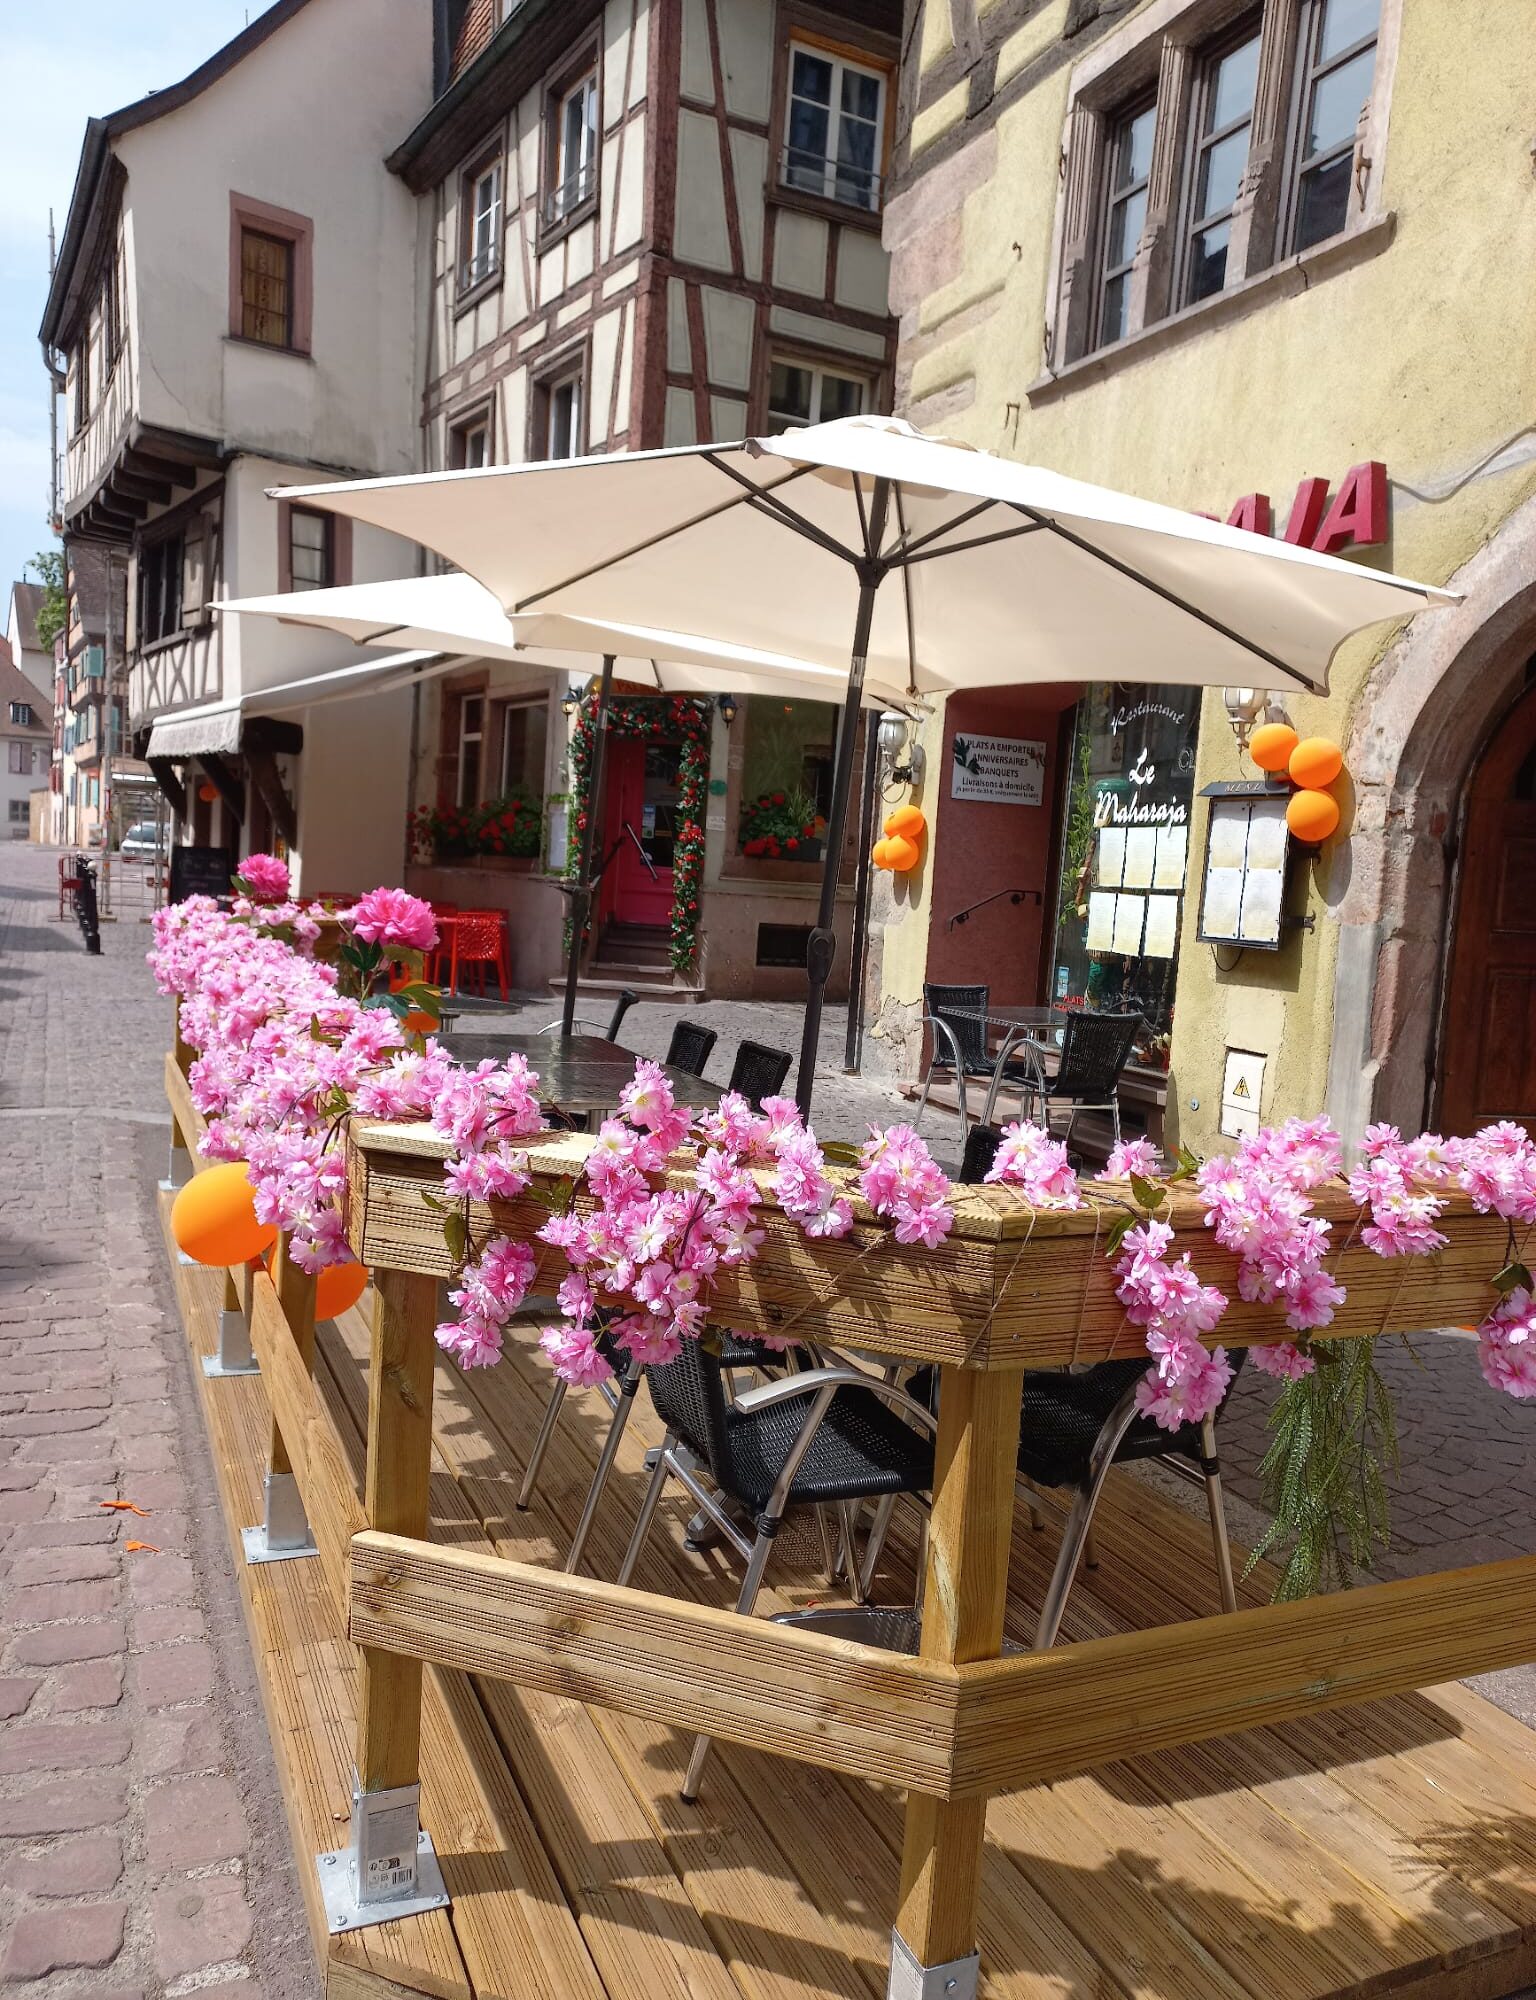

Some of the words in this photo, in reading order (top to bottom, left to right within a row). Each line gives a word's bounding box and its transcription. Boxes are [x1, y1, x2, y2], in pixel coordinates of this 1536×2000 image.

[1110, 700, 1185, 737] Restaurant
[967, 739, 989, 750] PLATS
[973, 753, 1029, 767] ANNIVERSAIRES
[1129, 747, 1155, 785] Le
[980, 766, 1019, 778] BANQUETS
[962, 776, 998, 788] Livraisons
[1004, 781, 1035, 792] domicile
[1093, 790, 1188, 839] Maharaja
